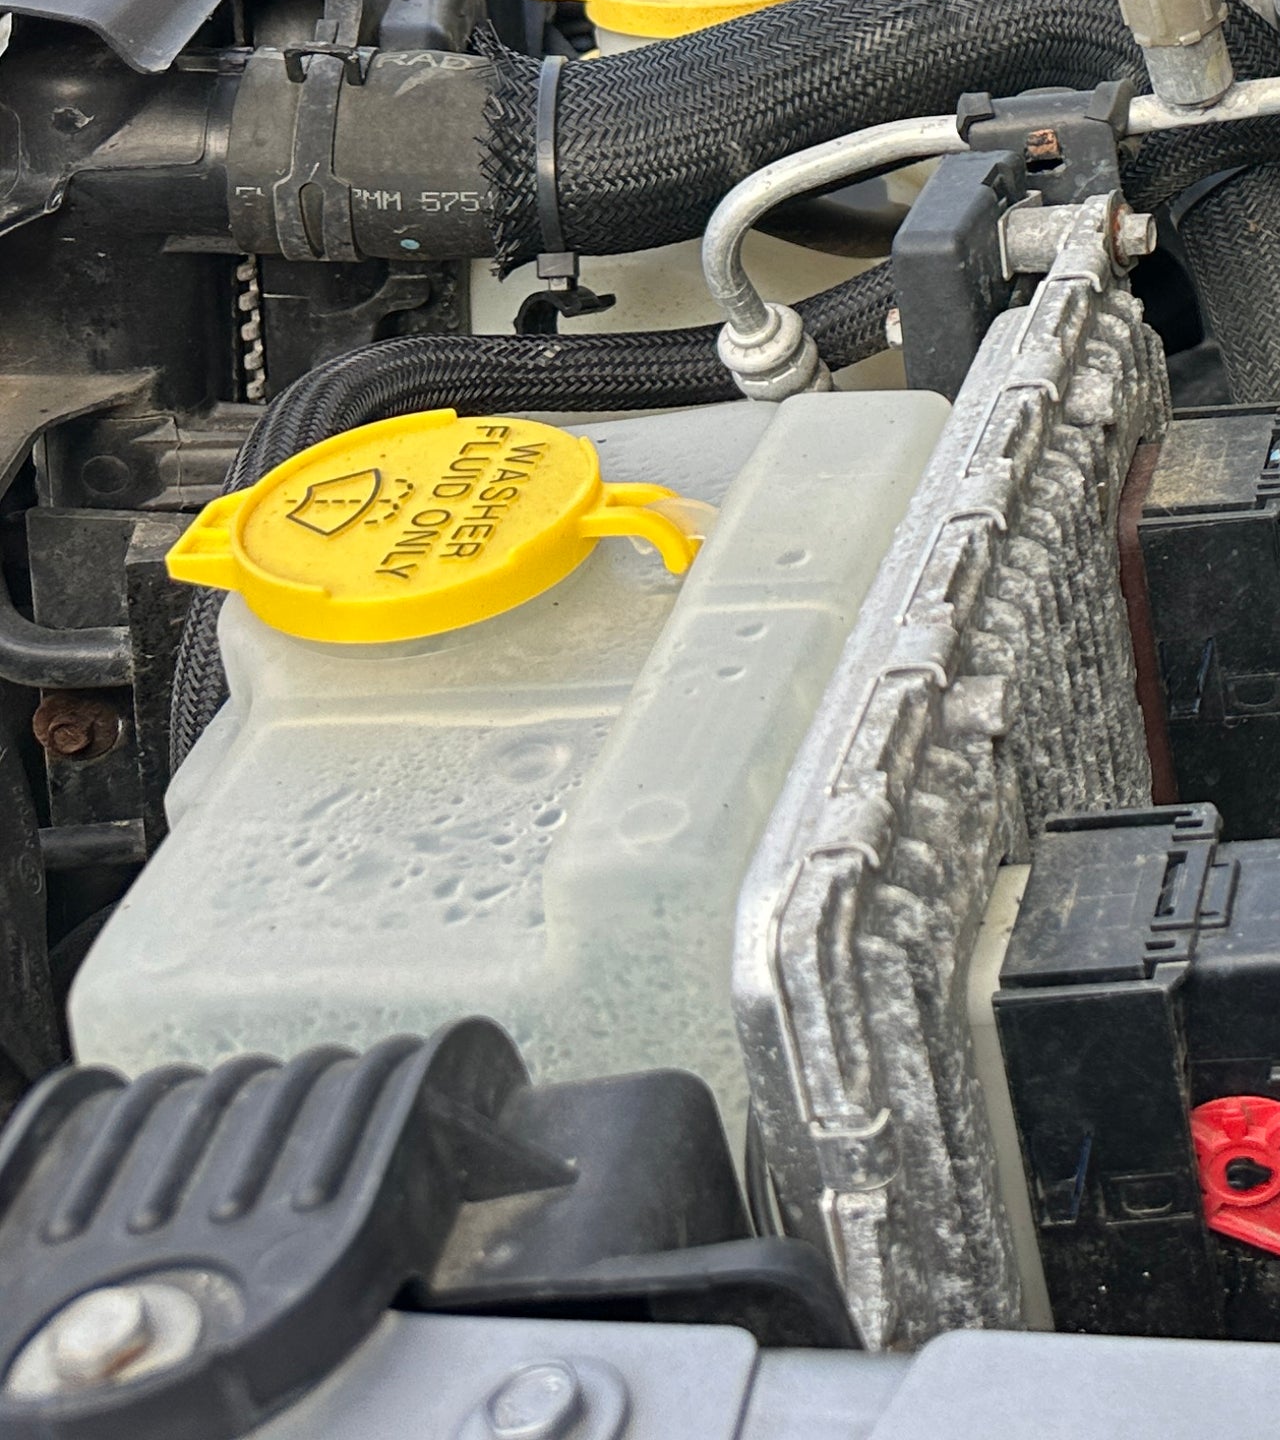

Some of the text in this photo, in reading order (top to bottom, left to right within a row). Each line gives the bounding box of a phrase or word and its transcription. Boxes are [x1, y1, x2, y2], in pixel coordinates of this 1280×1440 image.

[376, 53, 473, 71] RAD
[374, 425, 511, 580] FLUID ONLY
[440, 441, 547, 559] WASHER
